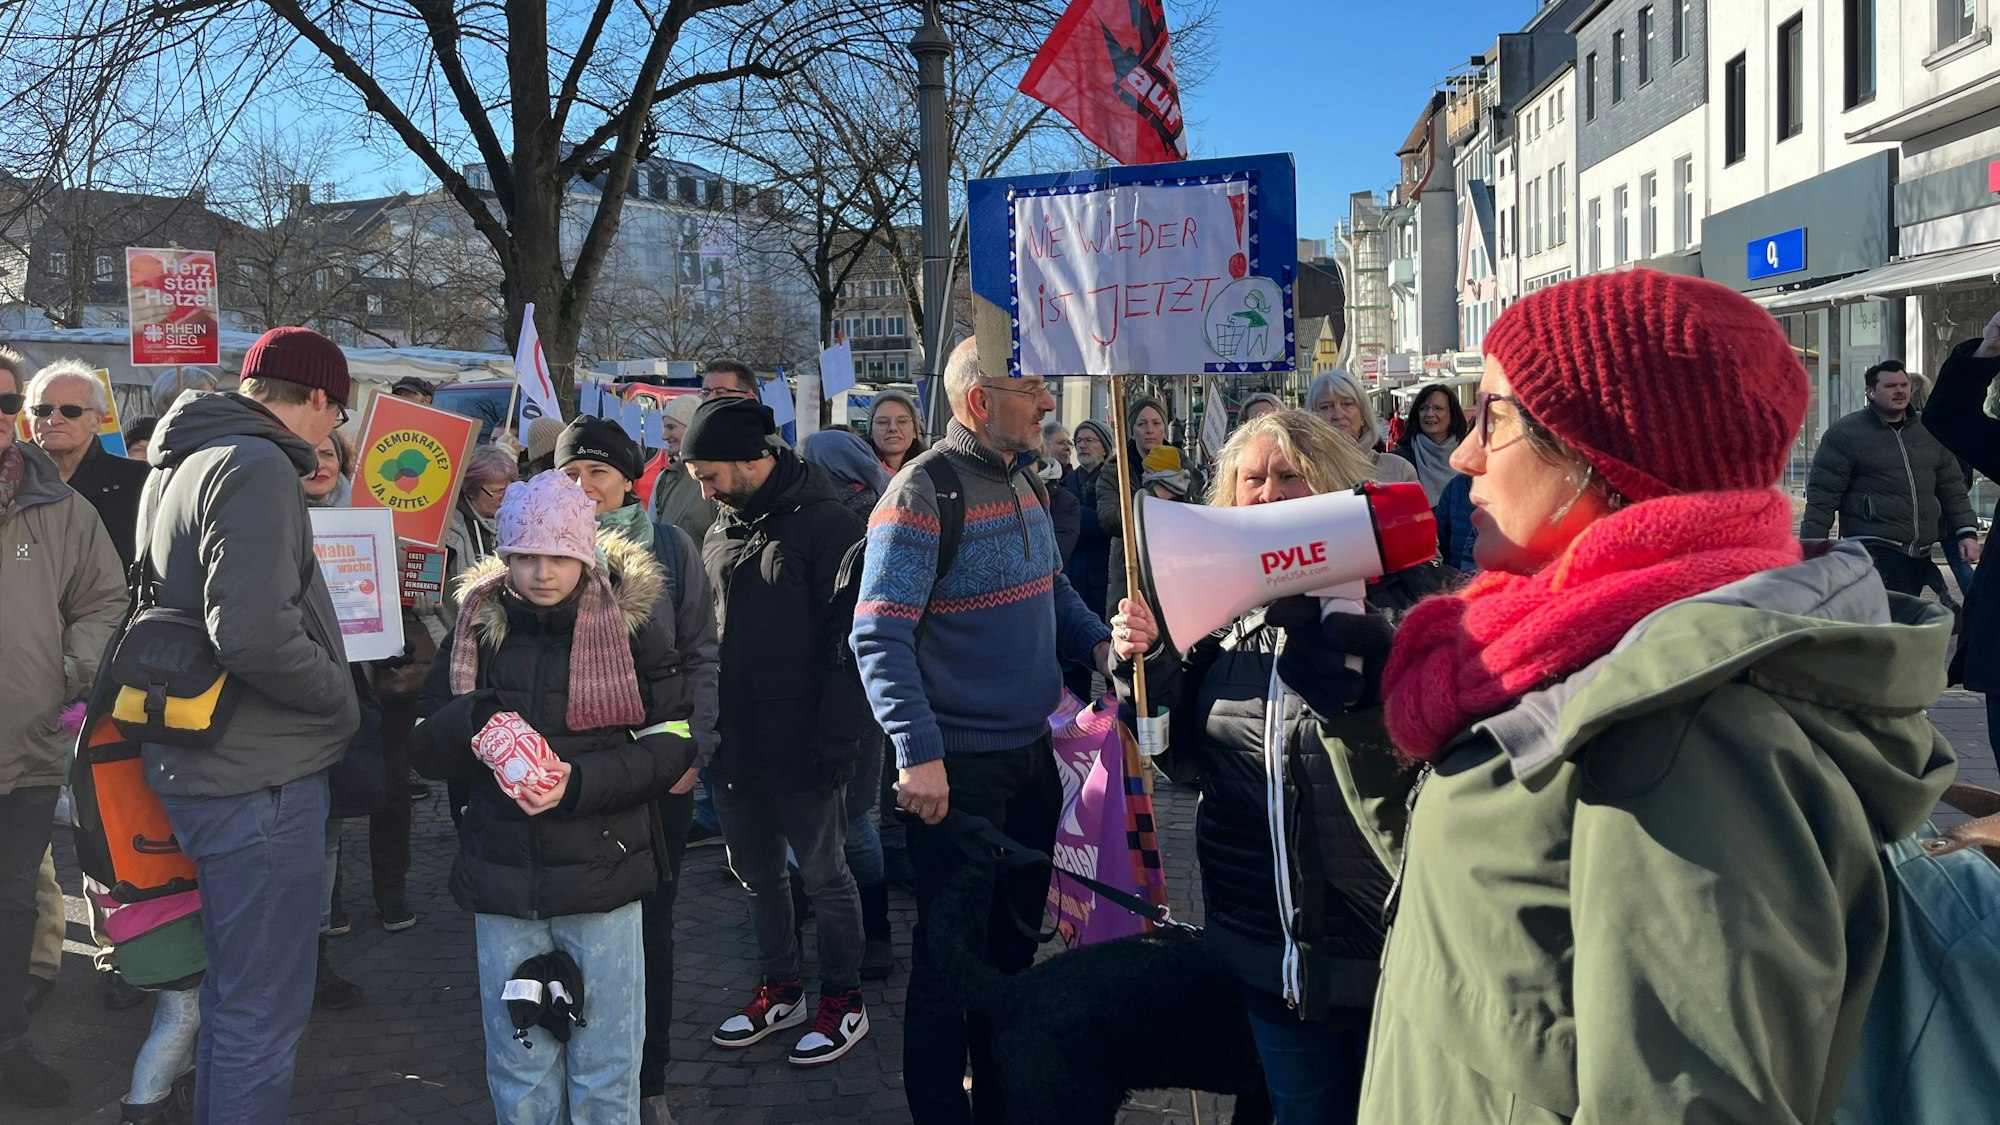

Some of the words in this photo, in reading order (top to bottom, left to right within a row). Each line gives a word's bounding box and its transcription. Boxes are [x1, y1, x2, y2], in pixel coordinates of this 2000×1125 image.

[162, 258, 212, 276] Herz
[164, 274, 212, 291] statt
[144, 288, 213, 307] Hetze!
[1088, 277, 1220, 347] JETZT
[165, 323, 207, 334] RHEIN
[166, 334, 198, 345] SIEG
[376, 432, 449, 471] DEMOKRATIE?
[372, 483, 386, 501] JA,
[388, 495, 429, 509] BITTE!
[313, 543, 356, 559] Mahn
[337, 561, 373, 574] wache
[1266, 565, 1330, 586] PyleUSA.com
